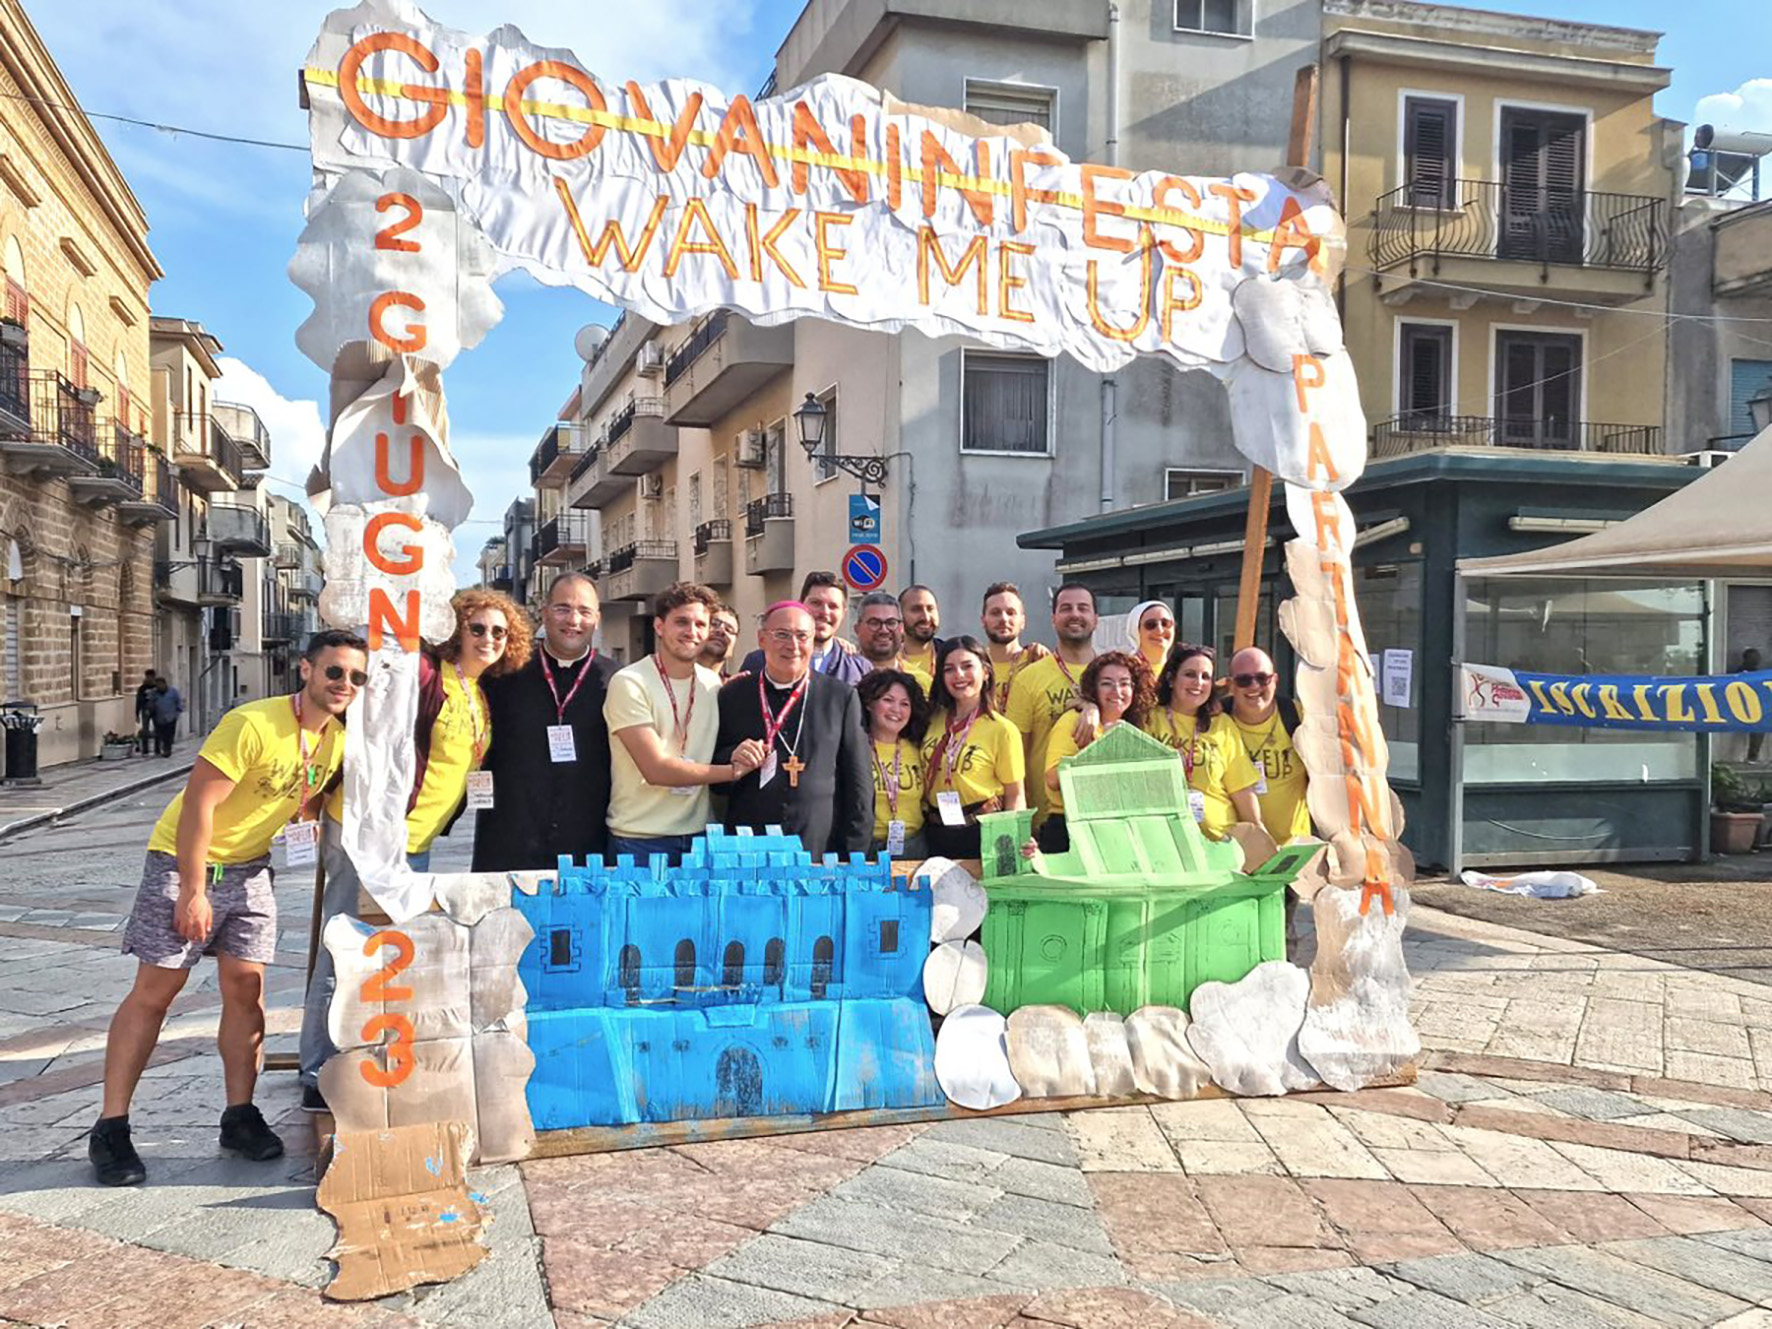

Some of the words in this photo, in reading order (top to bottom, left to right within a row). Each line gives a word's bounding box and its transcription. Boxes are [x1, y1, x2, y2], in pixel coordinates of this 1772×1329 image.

[374, 192, 423, 252] 2
[553, 174, 858, 296] WAKE
[916, 225, 1036, 324] ME
[1085, 221, 1203, 344] UP
